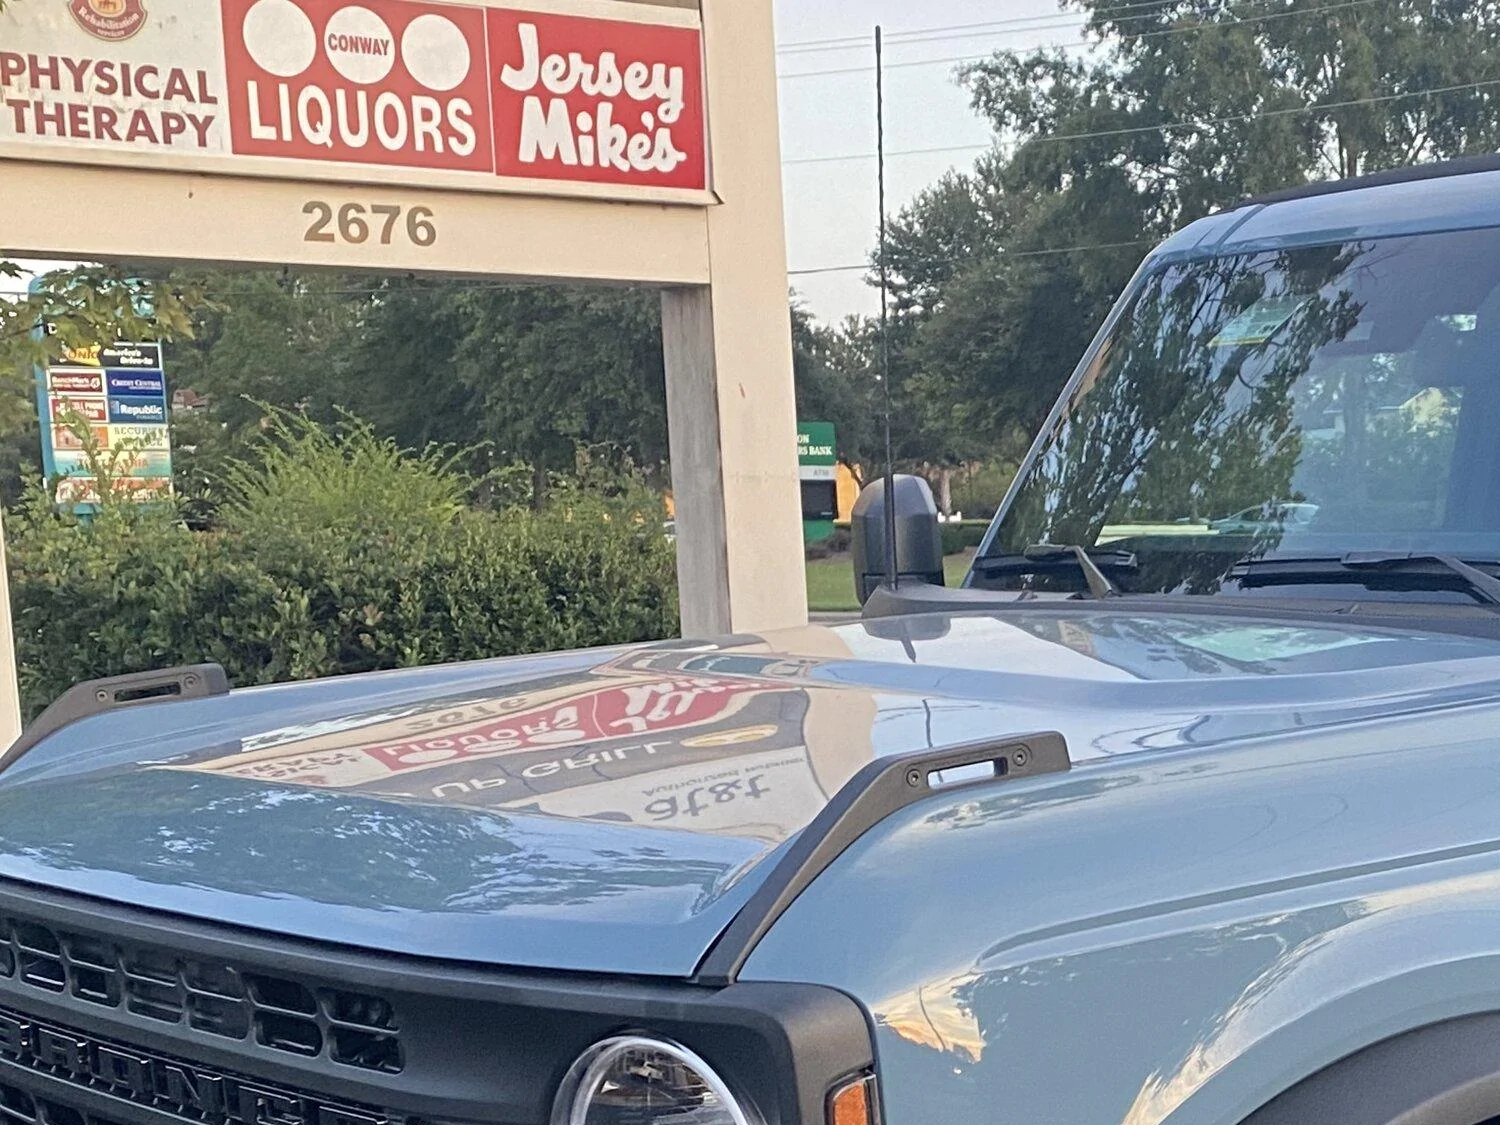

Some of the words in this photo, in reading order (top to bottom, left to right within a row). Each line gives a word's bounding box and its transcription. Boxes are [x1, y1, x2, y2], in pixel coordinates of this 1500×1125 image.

[78, 6, 139, 29] Rehabilitation
[327, 33, 390, 56] CONWAY
[0, 52, 218, 105] PHYSICAL
[499, 22, 686, 124] Jersey
[6, 98, 216, 148] THERAPY
[247, 80, 477, 157] LIQUORS
[518, 95, 688, 173] Mike's
[302, 200, 437, 247] 2676
[120, 404, 162, 416] Republic
[809, 446, 832, 456] BANK
